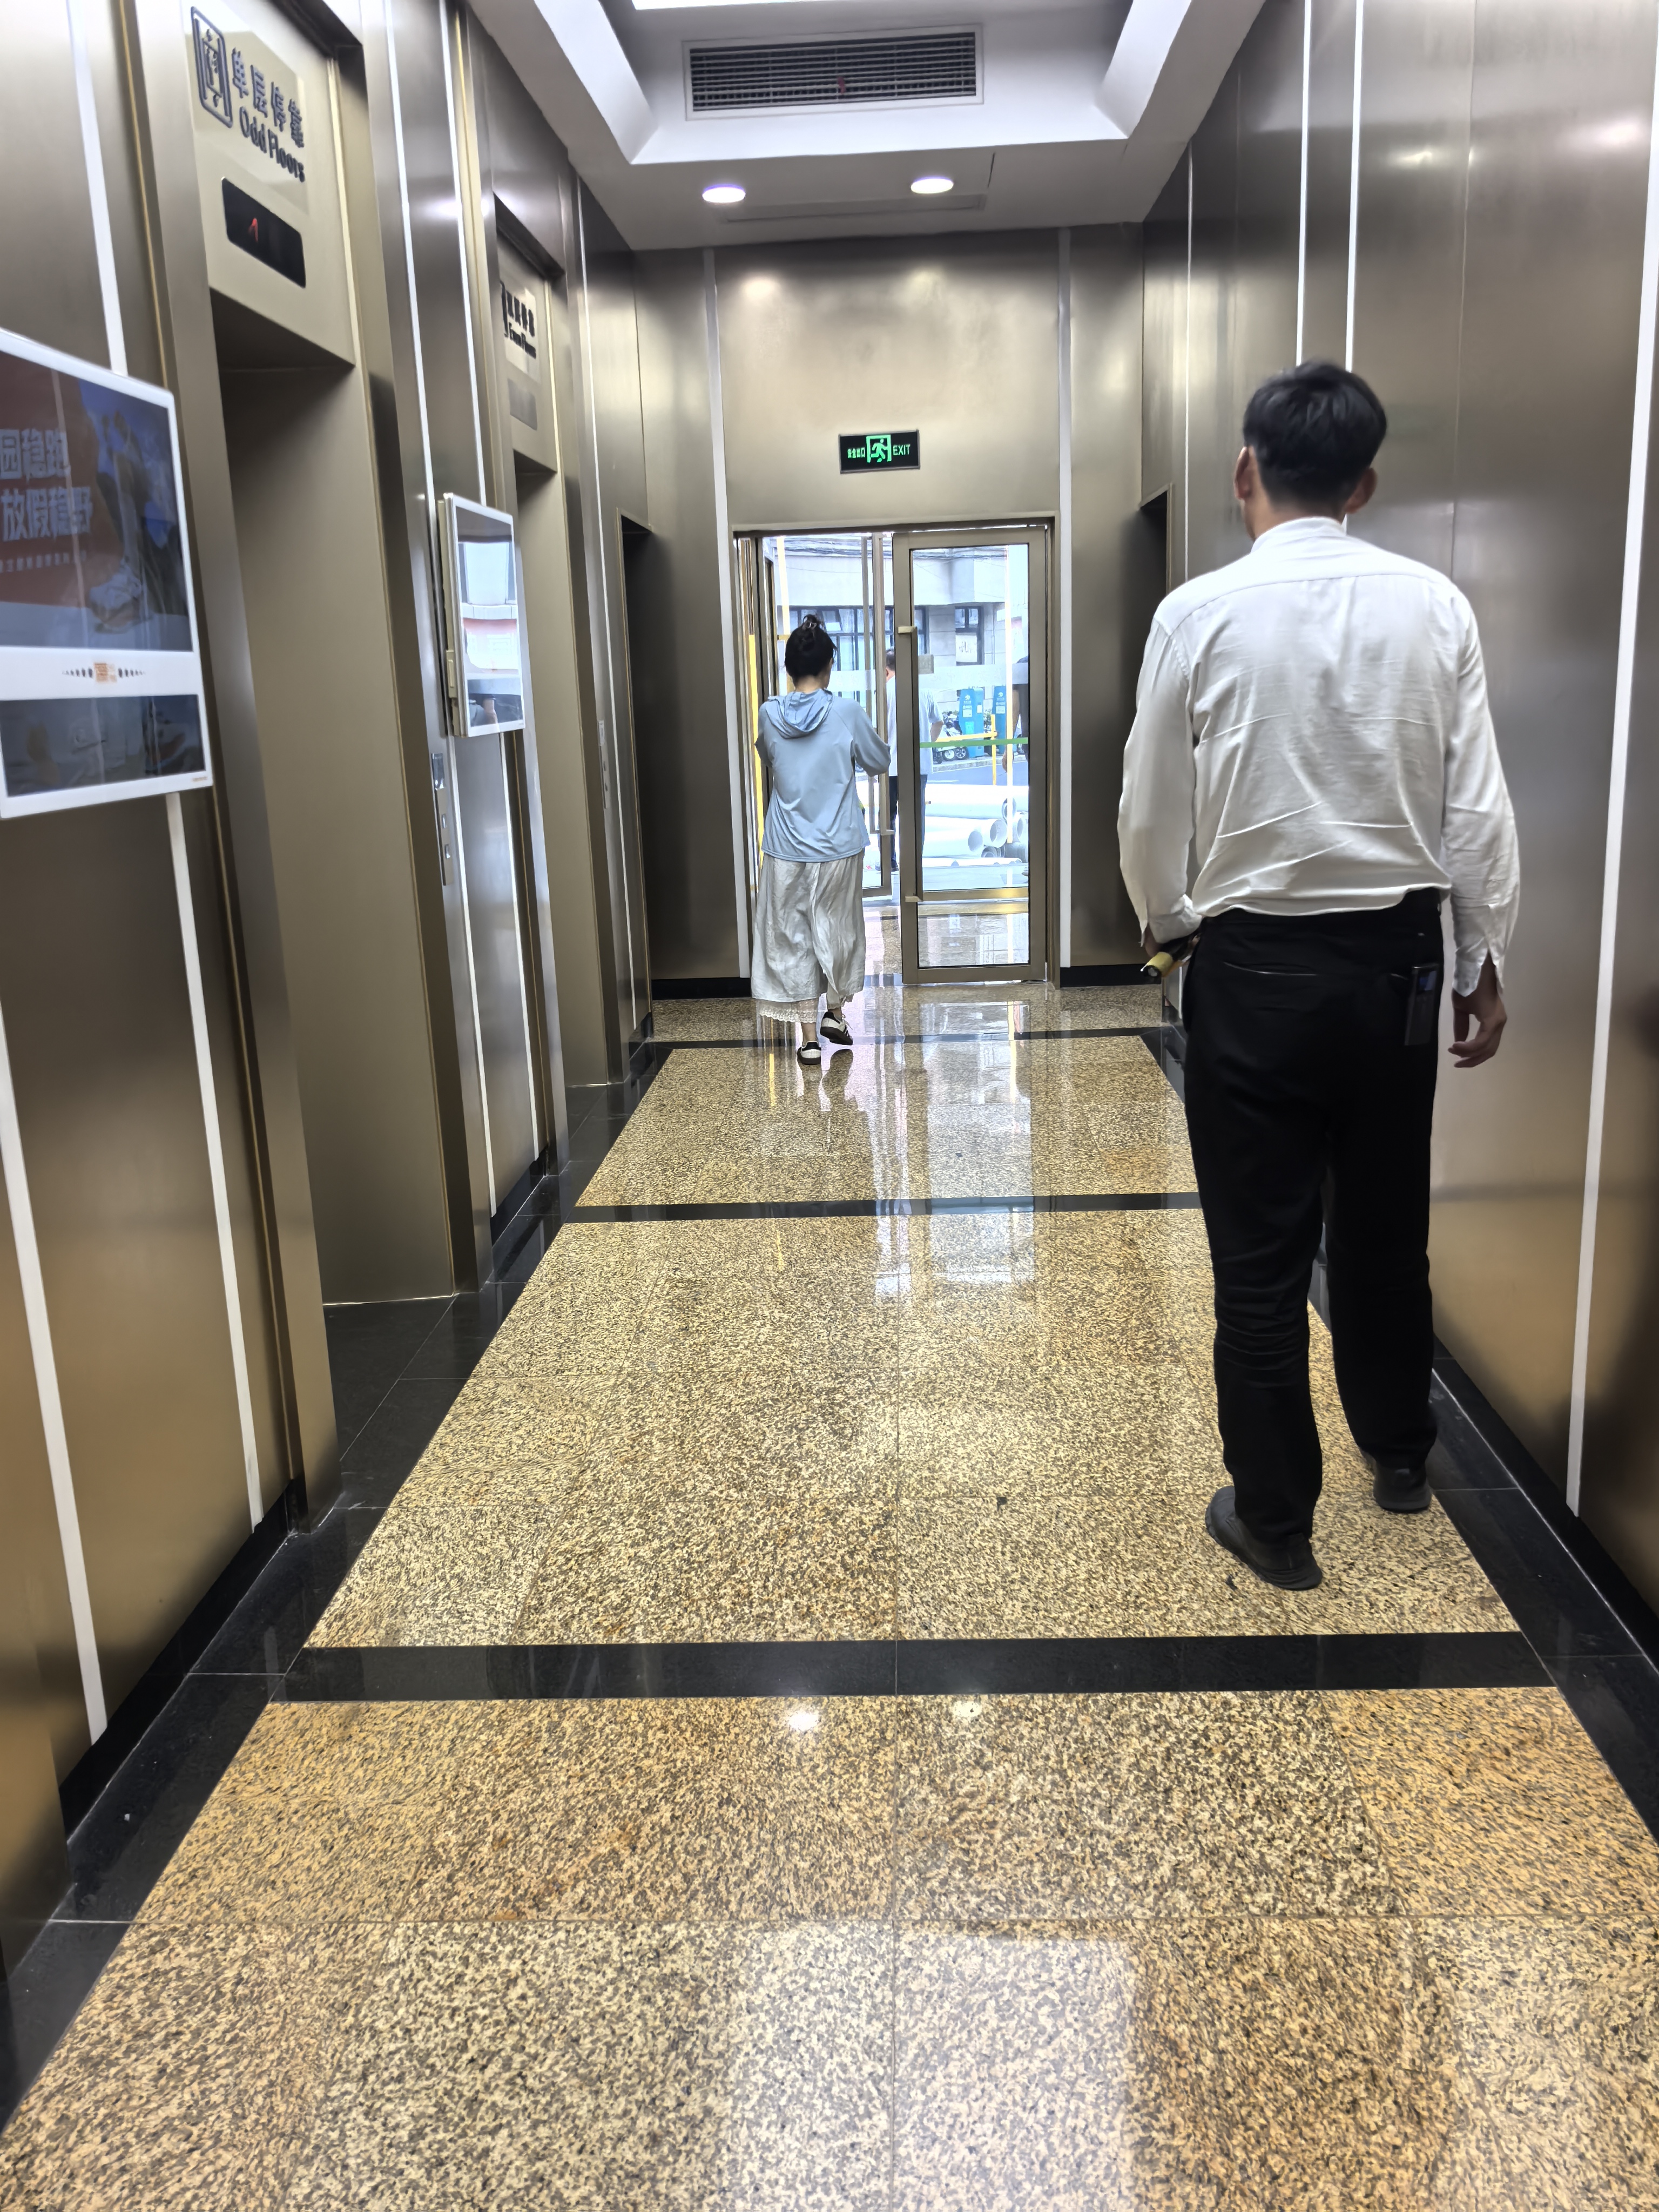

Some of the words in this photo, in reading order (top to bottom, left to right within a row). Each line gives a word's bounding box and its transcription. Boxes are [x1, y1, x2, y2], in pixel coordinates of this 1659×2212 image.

[231, 47, 305, 148] 单层停靠
[239, 106, 266, 153] Odd
[268, 128, 306, 183] Floors
[847, 447, 866, 458] 安全出口
[893, 444, 911, 455] EXIT
